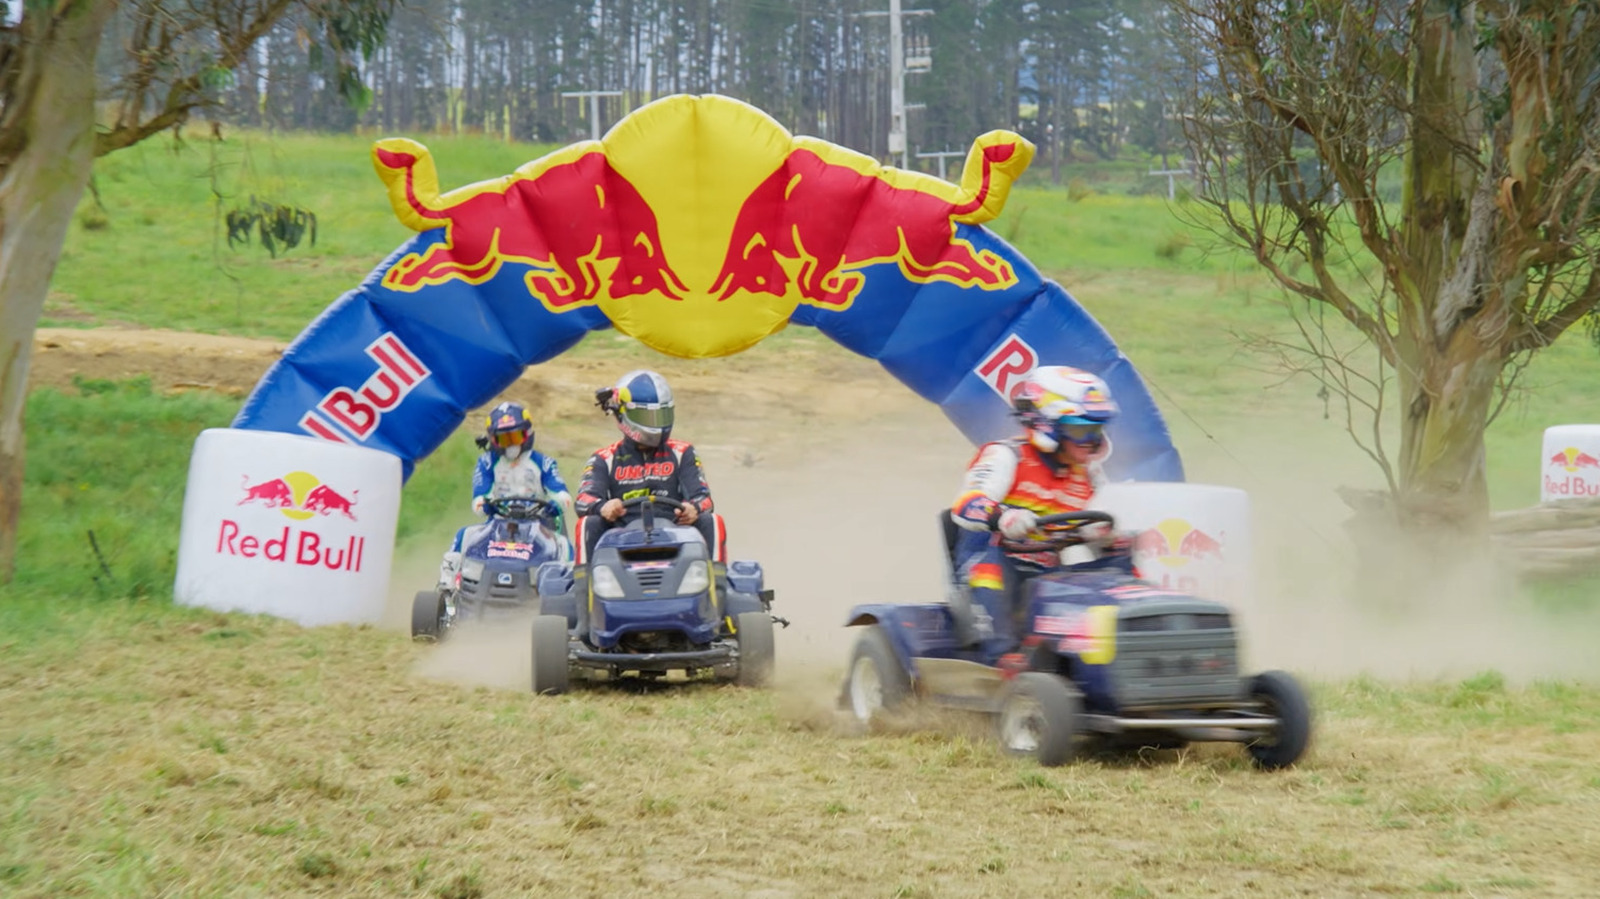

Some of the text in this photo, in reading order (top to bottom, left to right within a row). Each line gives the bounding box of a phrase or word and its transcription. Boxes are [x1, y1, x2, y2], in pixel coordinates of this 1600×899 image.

[322, 335, 427, 438] Bull
[615, 462, 675, 481] UNITED
[1573, 476, 1600, 496] Bu
[216, 519, 366, 573] Red Bull
